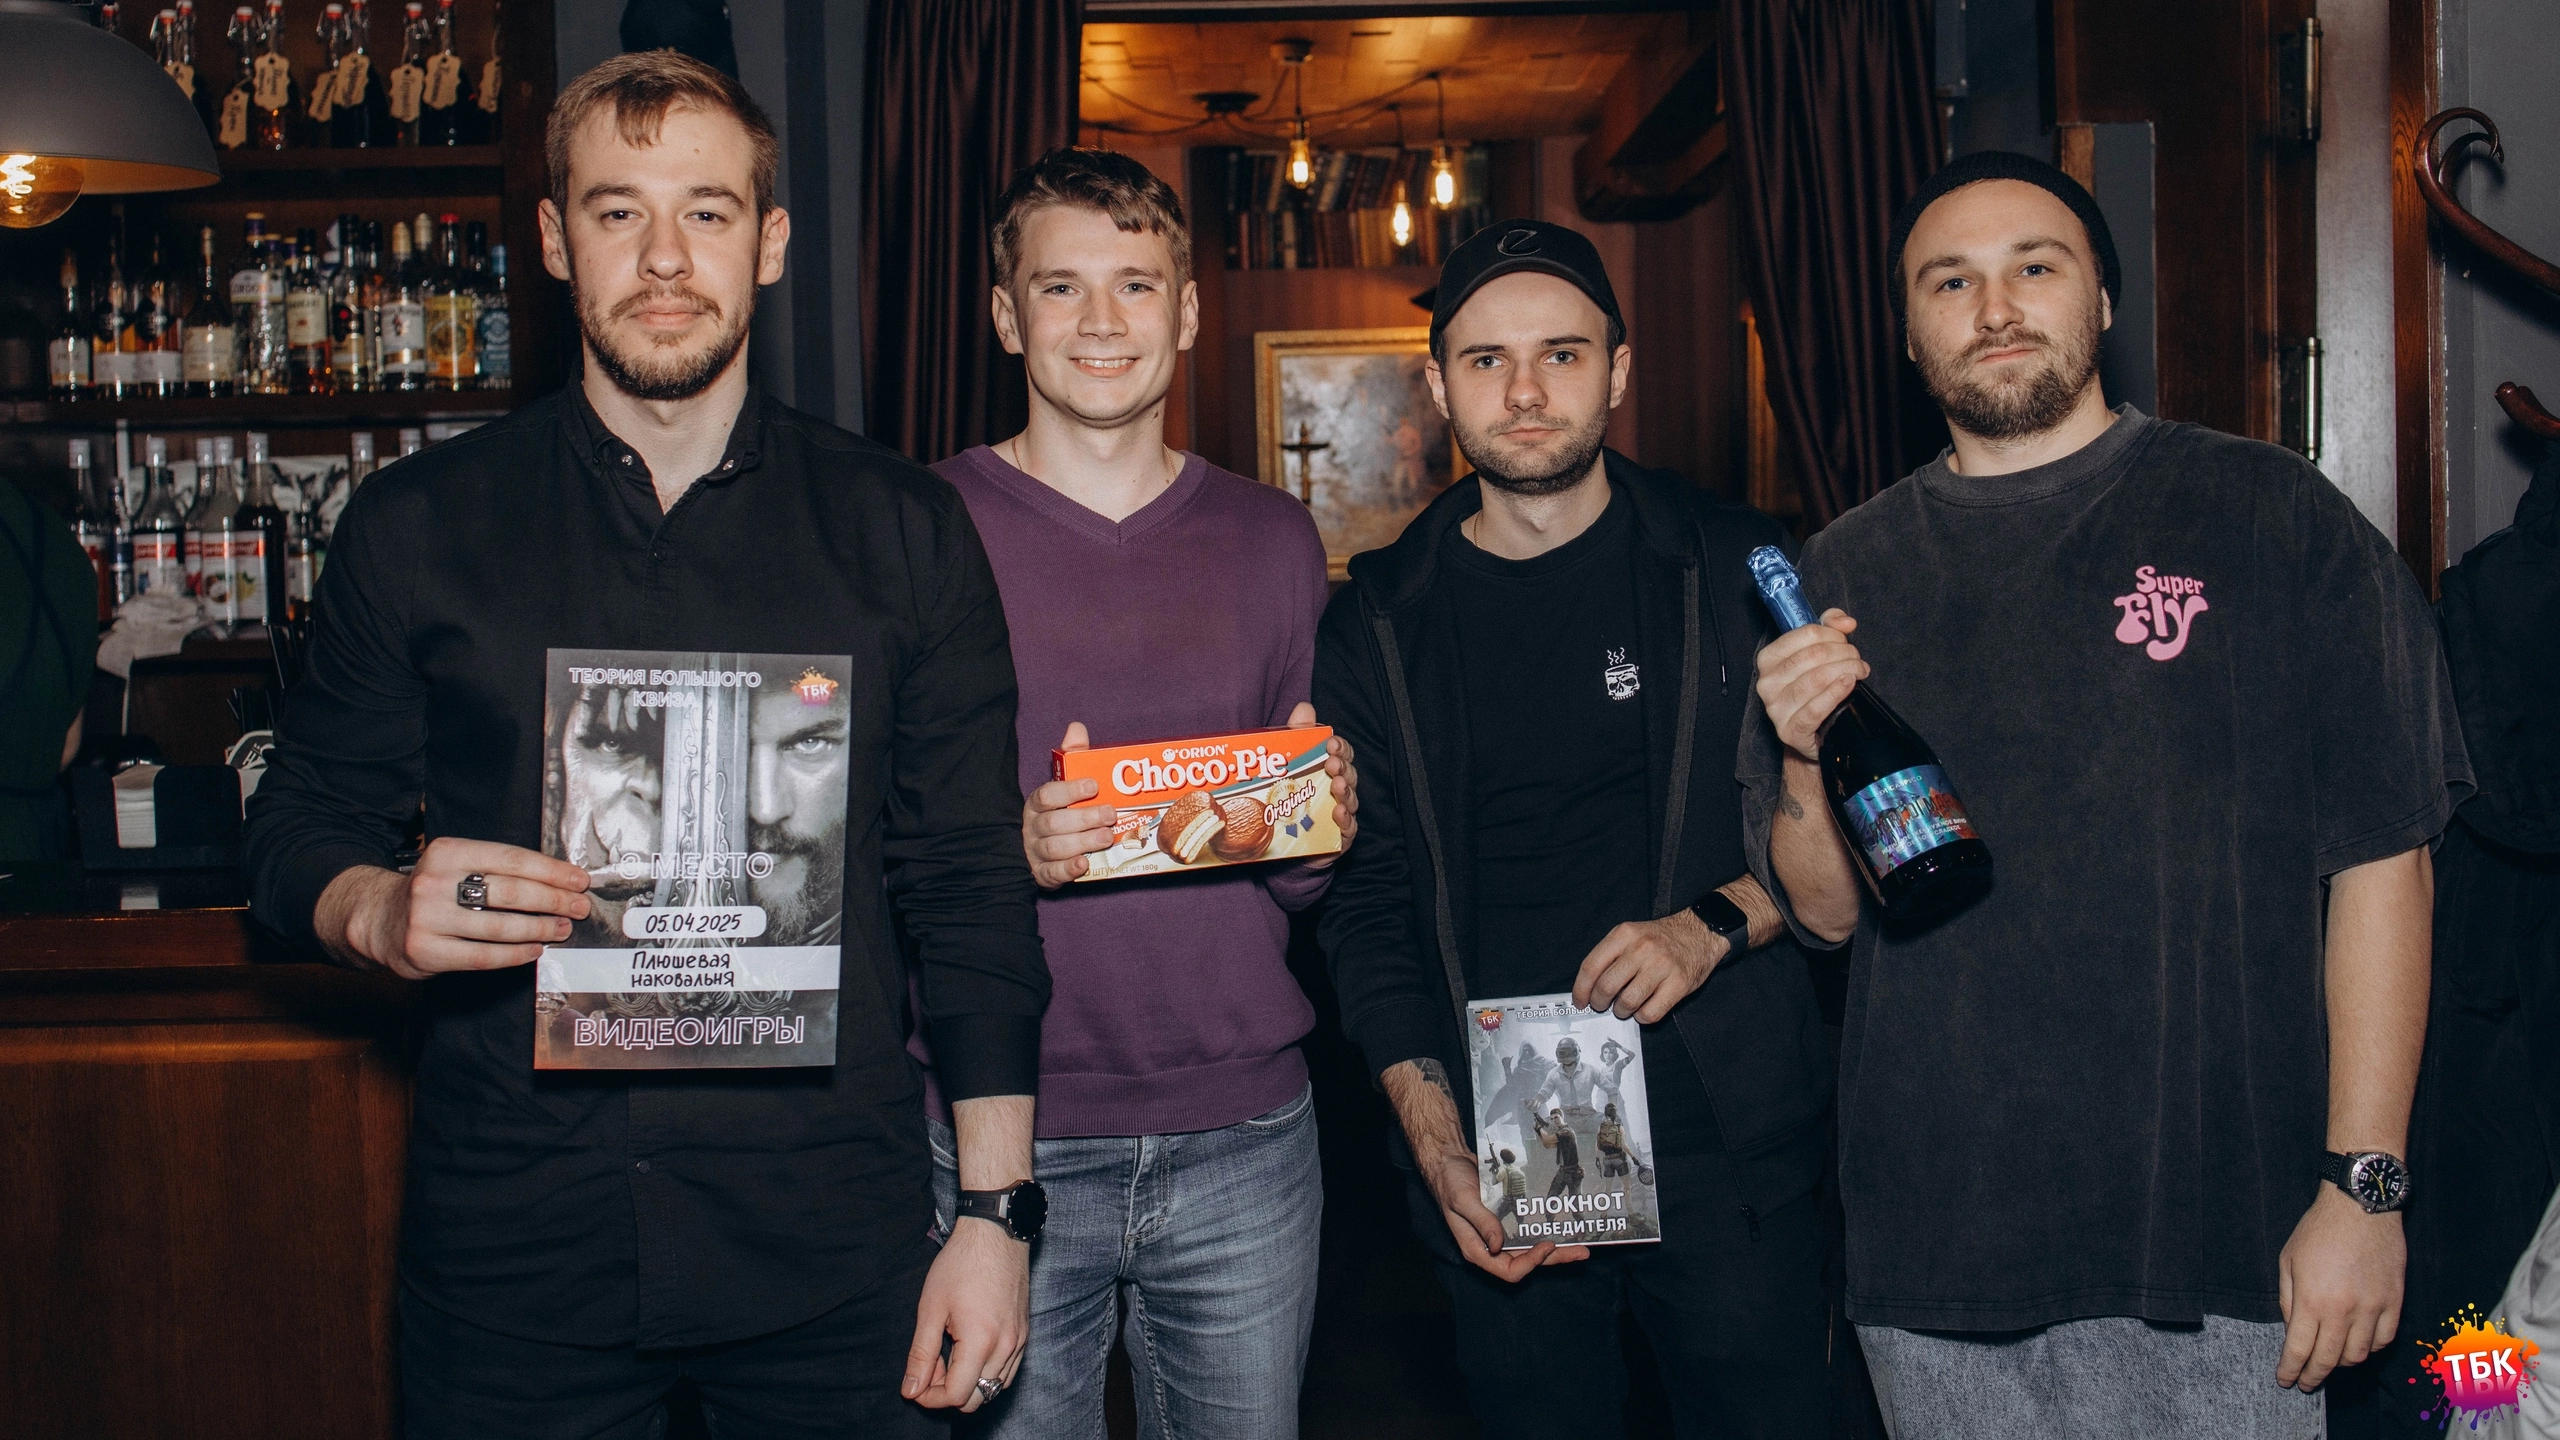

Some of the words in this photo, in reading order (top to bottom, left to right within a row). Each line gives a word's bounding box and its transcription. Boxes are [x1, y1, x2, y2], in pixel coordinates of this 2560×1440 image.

[2135, 565, 2205, 600] Super
[2113, 591, 2209, 661] Fly
[569, 667, 646, 686] ТЕОРИЯ
[650, 669, 762, 688] БОЛЬШОГО
[633, 690, 697, 708] КВИЗА
[800, 683, 830, 697] ТБК
[1178, 744, 1226, 760] ORION
[1263, 779, 1316, 826] Original
[620, 853, 642, 879] 3
[650, 852, 774, 880] МЕСТО
[645, 913, 743, 934] 05.04.2025
[632, 950, 731, 970] Плюшевая
[631, 971, 735, 988] наковальня
[1480, 1014, 1499, 1026] ТБК
[1516, 1009, 1550, 1019] ТЕОРИЯ
[1553, 1006, 1595, 1016] БОЛЬШО
[574, 1016, 806, 1050] ВИДЕОИГРЫ
[1515, 1191, 1625, 1217] БЛОКНОТ
[1518, 1217, 1627, 1238] ПОБЕДИТЕЛЯ
